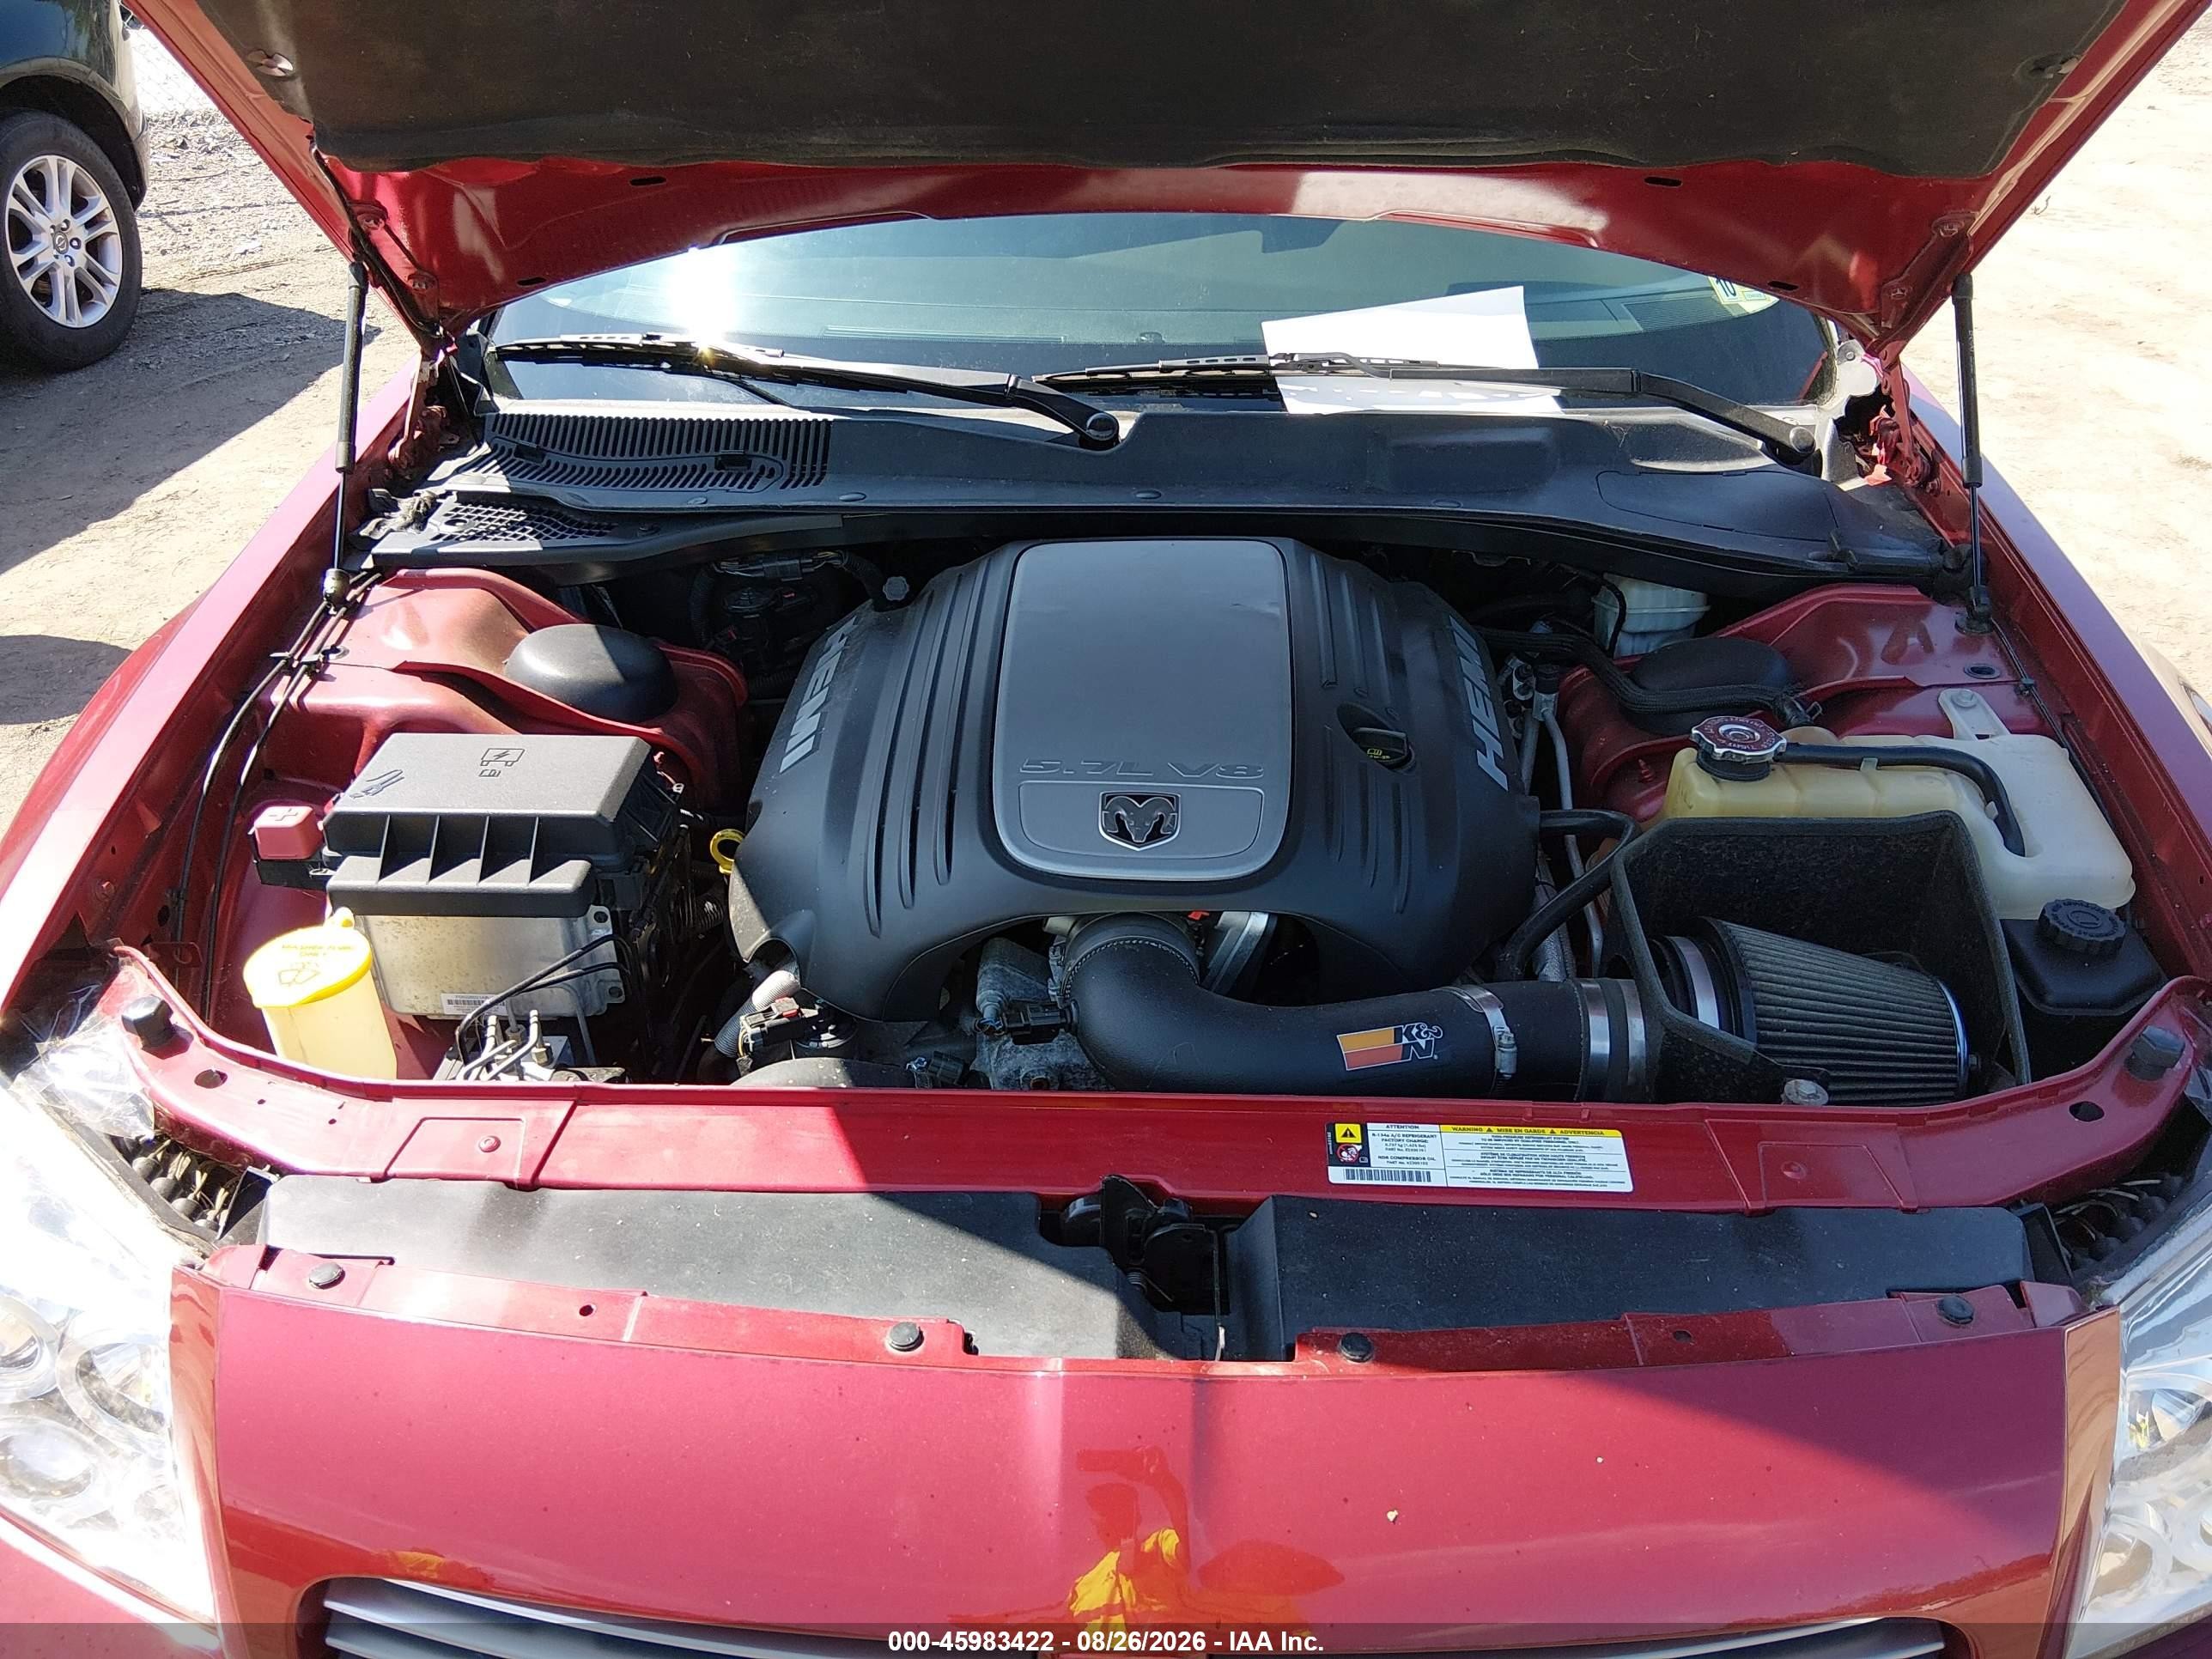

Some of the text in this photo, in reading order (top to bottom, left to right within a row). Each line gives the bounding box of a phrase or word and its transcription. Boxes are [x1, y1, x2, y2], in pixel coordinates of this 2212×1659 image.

[1449, 615, 1509, 791] HEMI
[1019, 758, 1264, 780] 5.7L V8
